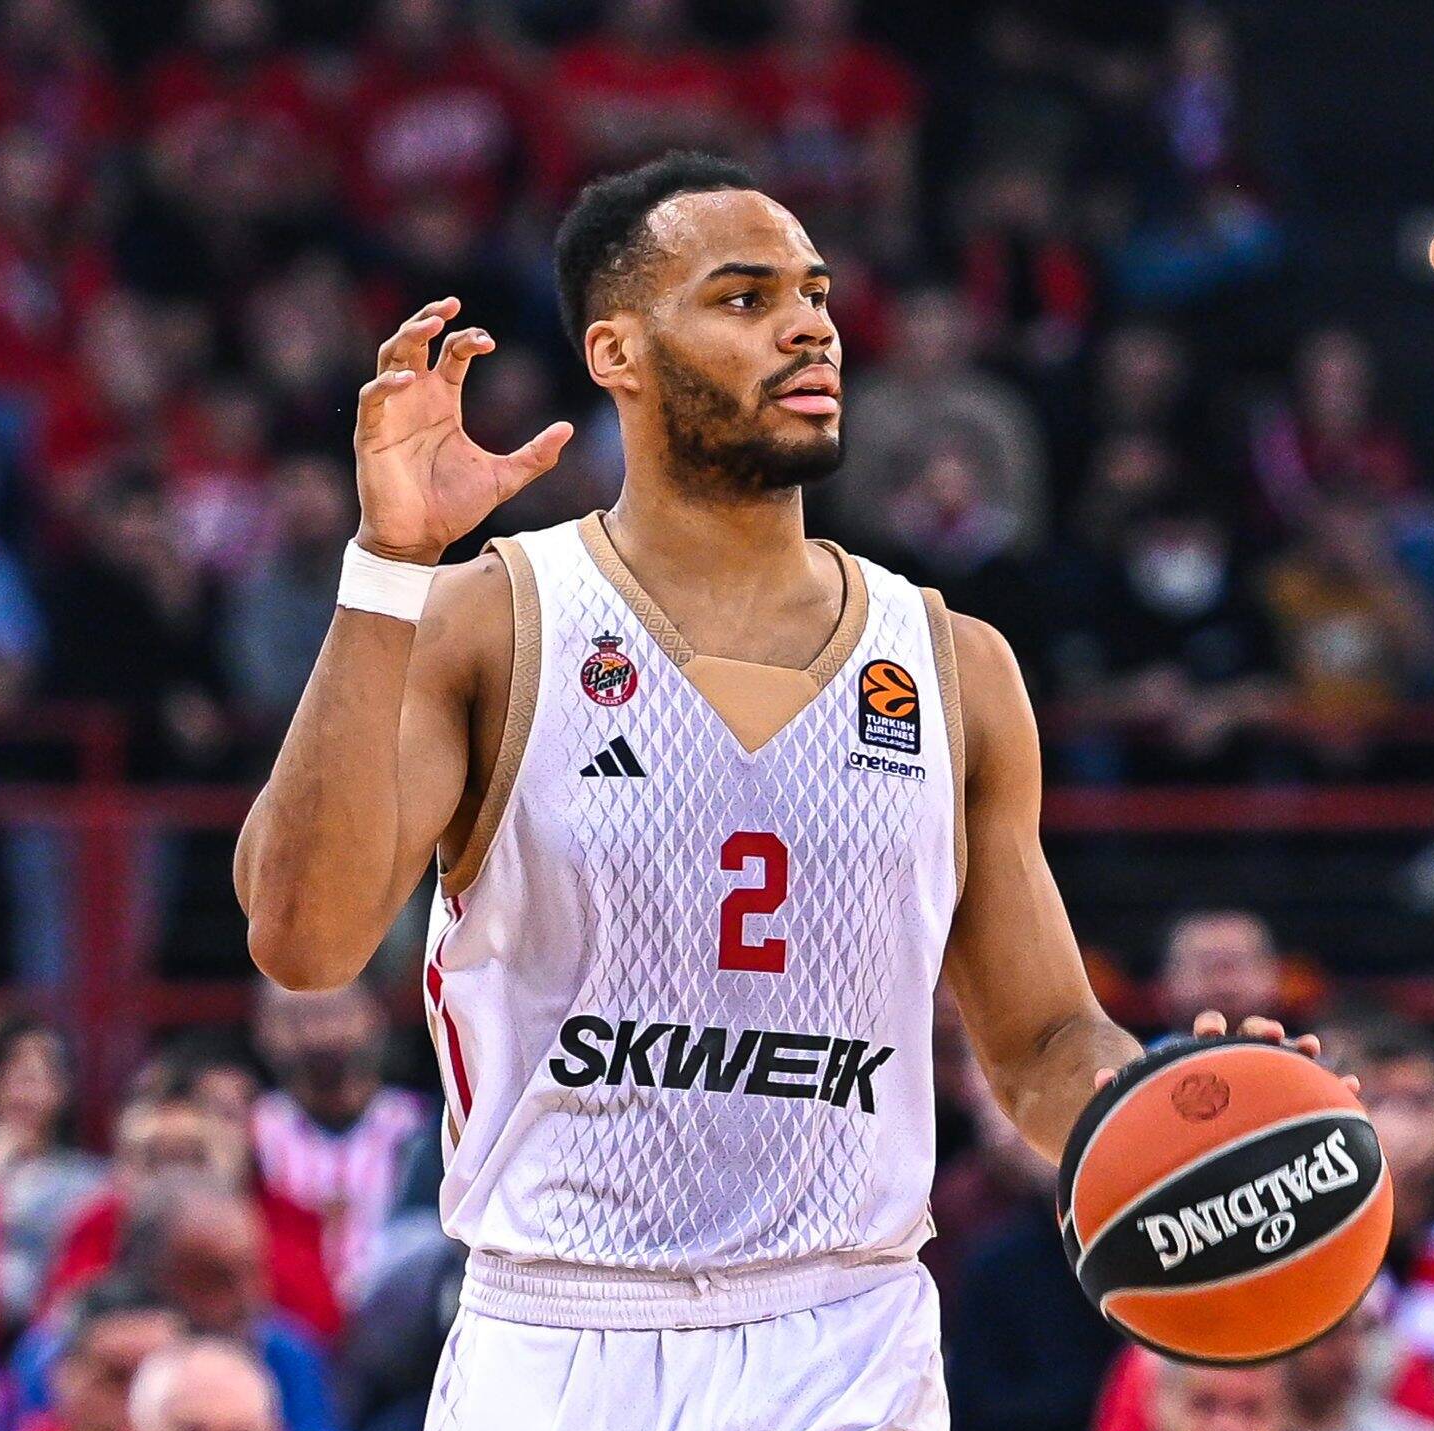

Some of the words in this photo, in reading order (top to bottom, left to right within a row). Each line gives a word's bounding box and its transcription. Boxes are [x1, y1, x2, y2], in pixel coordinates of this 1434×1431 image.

[865, 713, 916, 733] TURKISH
[865, 724, 916, 742] AIRLINES
[850, 751, 926, 780] oneteam
[718, 831, 788, 974] 2
[1143, 1128, 1359, 1271] SPALDING
